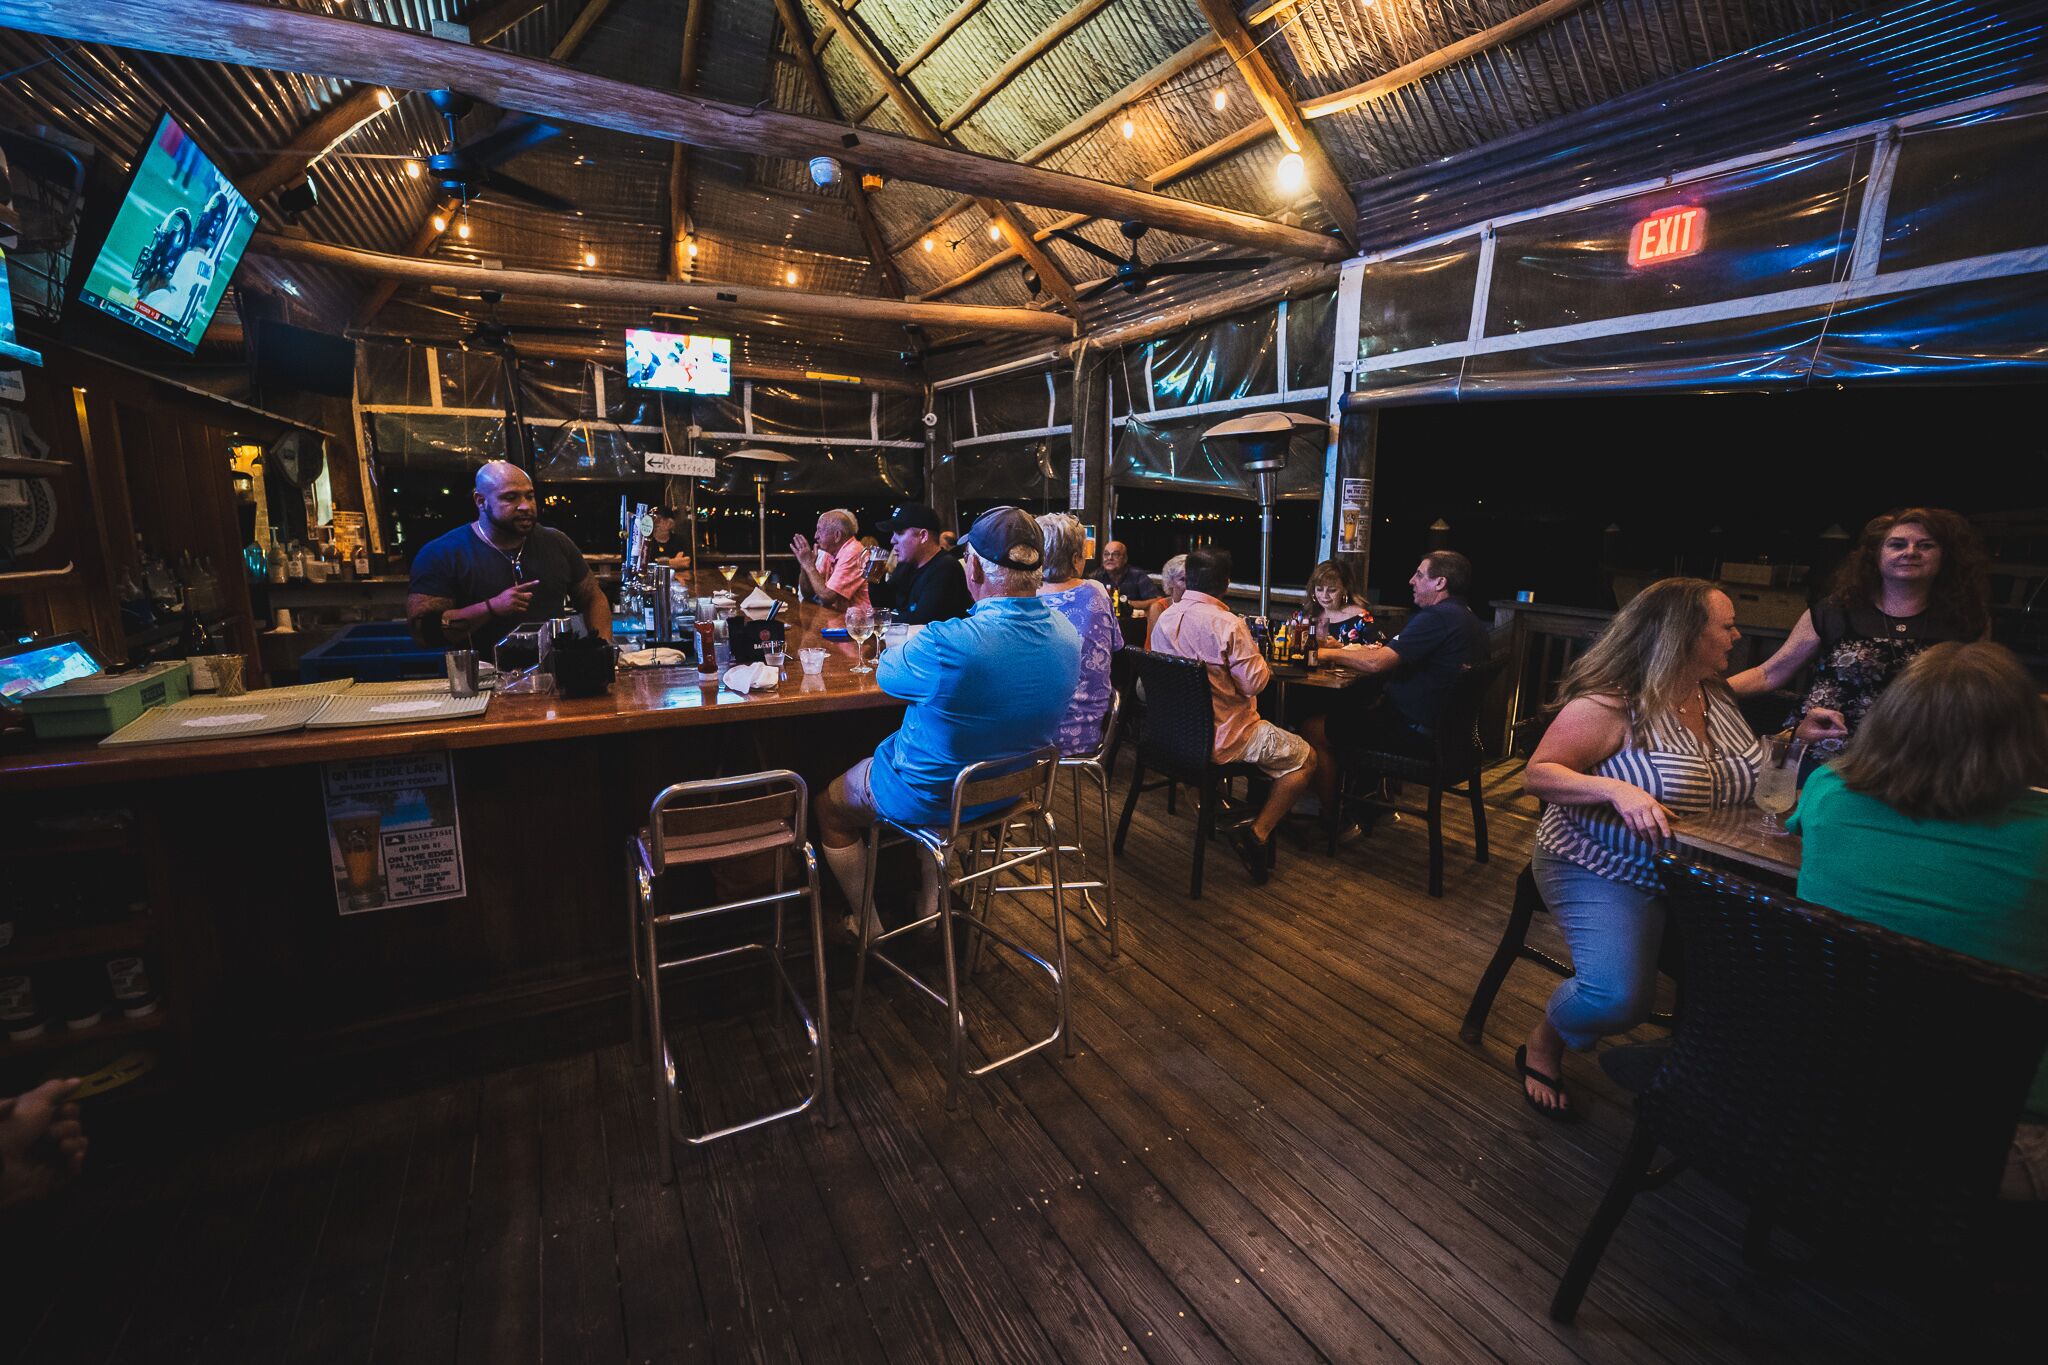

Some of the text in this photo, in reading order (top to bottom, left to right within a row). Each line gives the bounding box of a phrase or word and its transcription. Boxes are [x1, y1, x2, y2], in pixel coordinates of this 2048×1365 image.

[1639, 210, 1697, 260] EXIT
[332, 763, 443, 781] ON THE EDGE LAGER
[340, 783, 370, 792] ENJOY
[405, 777, 437, 786] TODAY
[407, 829, 452, 840] SAILFISH
[388, 849, 454, 864] ON THE EDGE
[389, 856, 454, 870] FALL FESTIVAL
